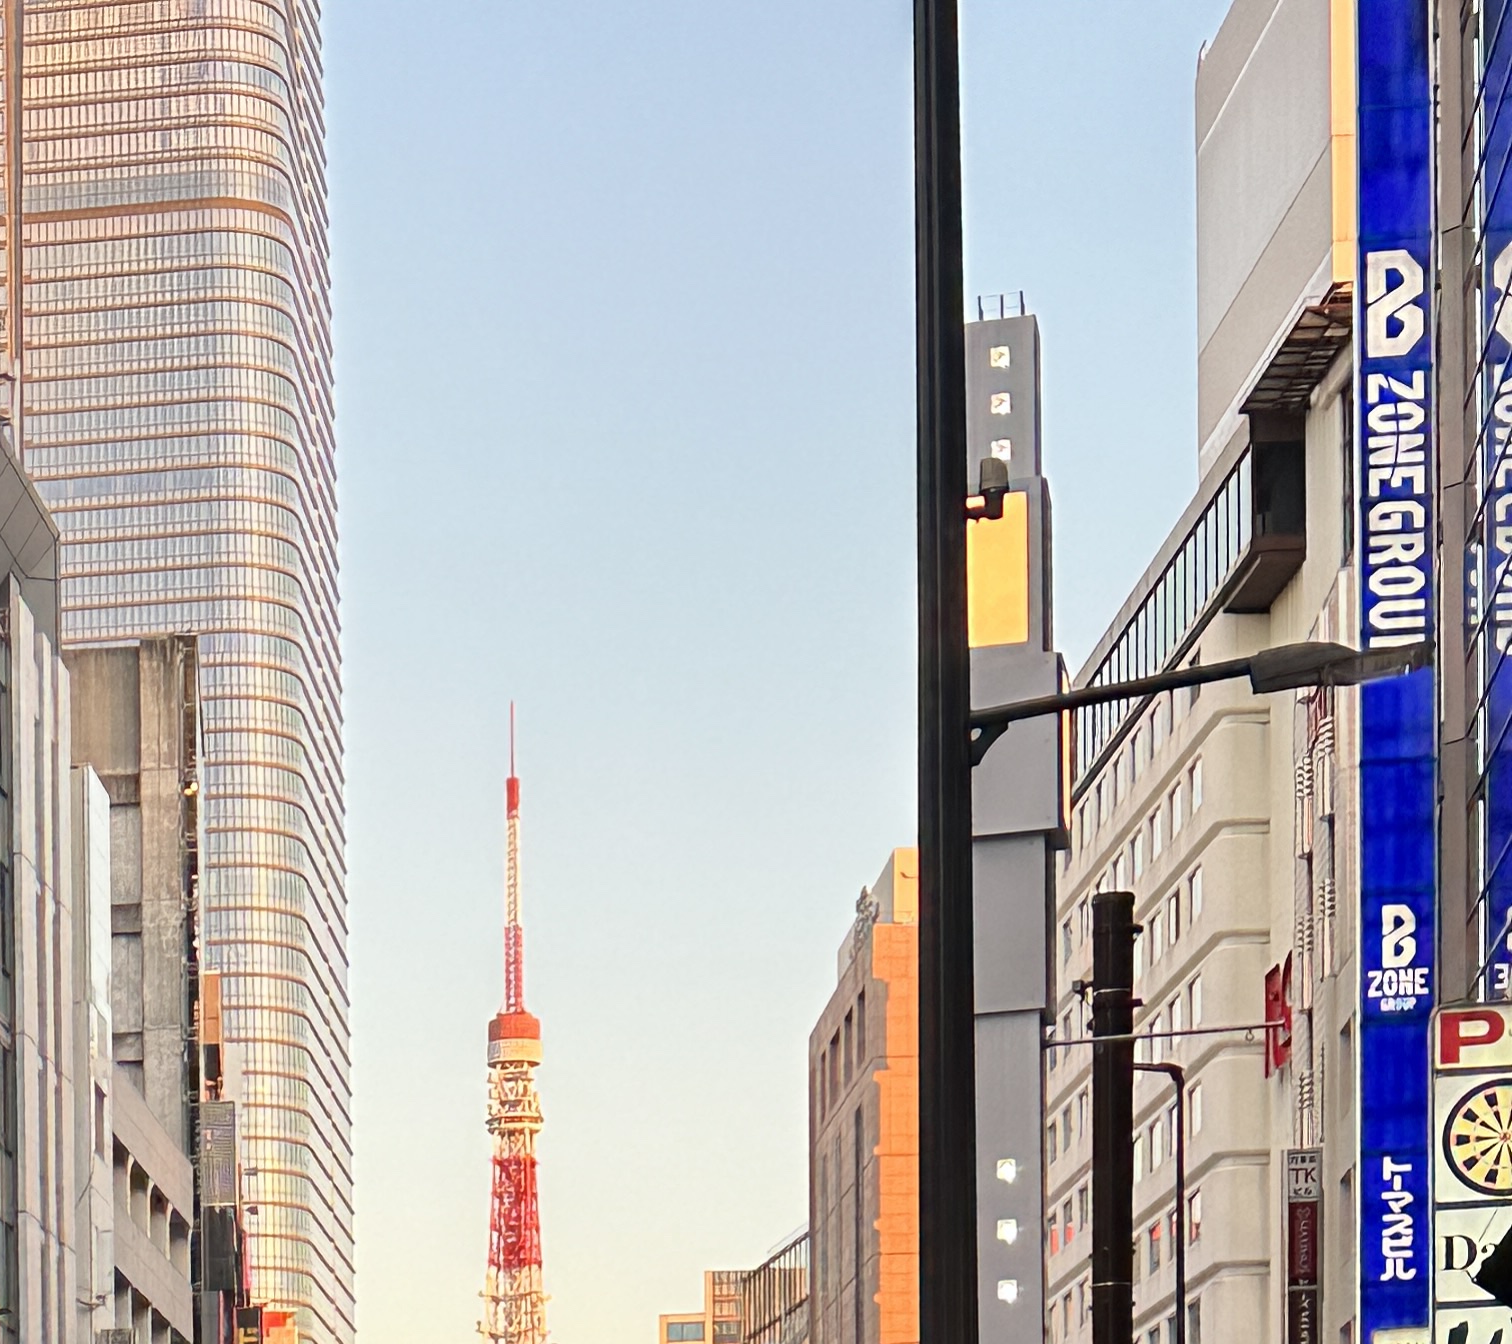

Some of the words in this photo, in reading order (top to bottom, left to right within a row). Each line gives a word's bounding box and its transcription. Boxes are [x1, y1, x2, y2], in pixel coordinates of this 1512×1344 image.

[1367, 370, 1425, 497] ZONE
[1367, 967, 1429, 998] ZONE
[1289, 1167, 1316, 1184] TK
[1379, 1155, 1418, 1282] トーマスビル
